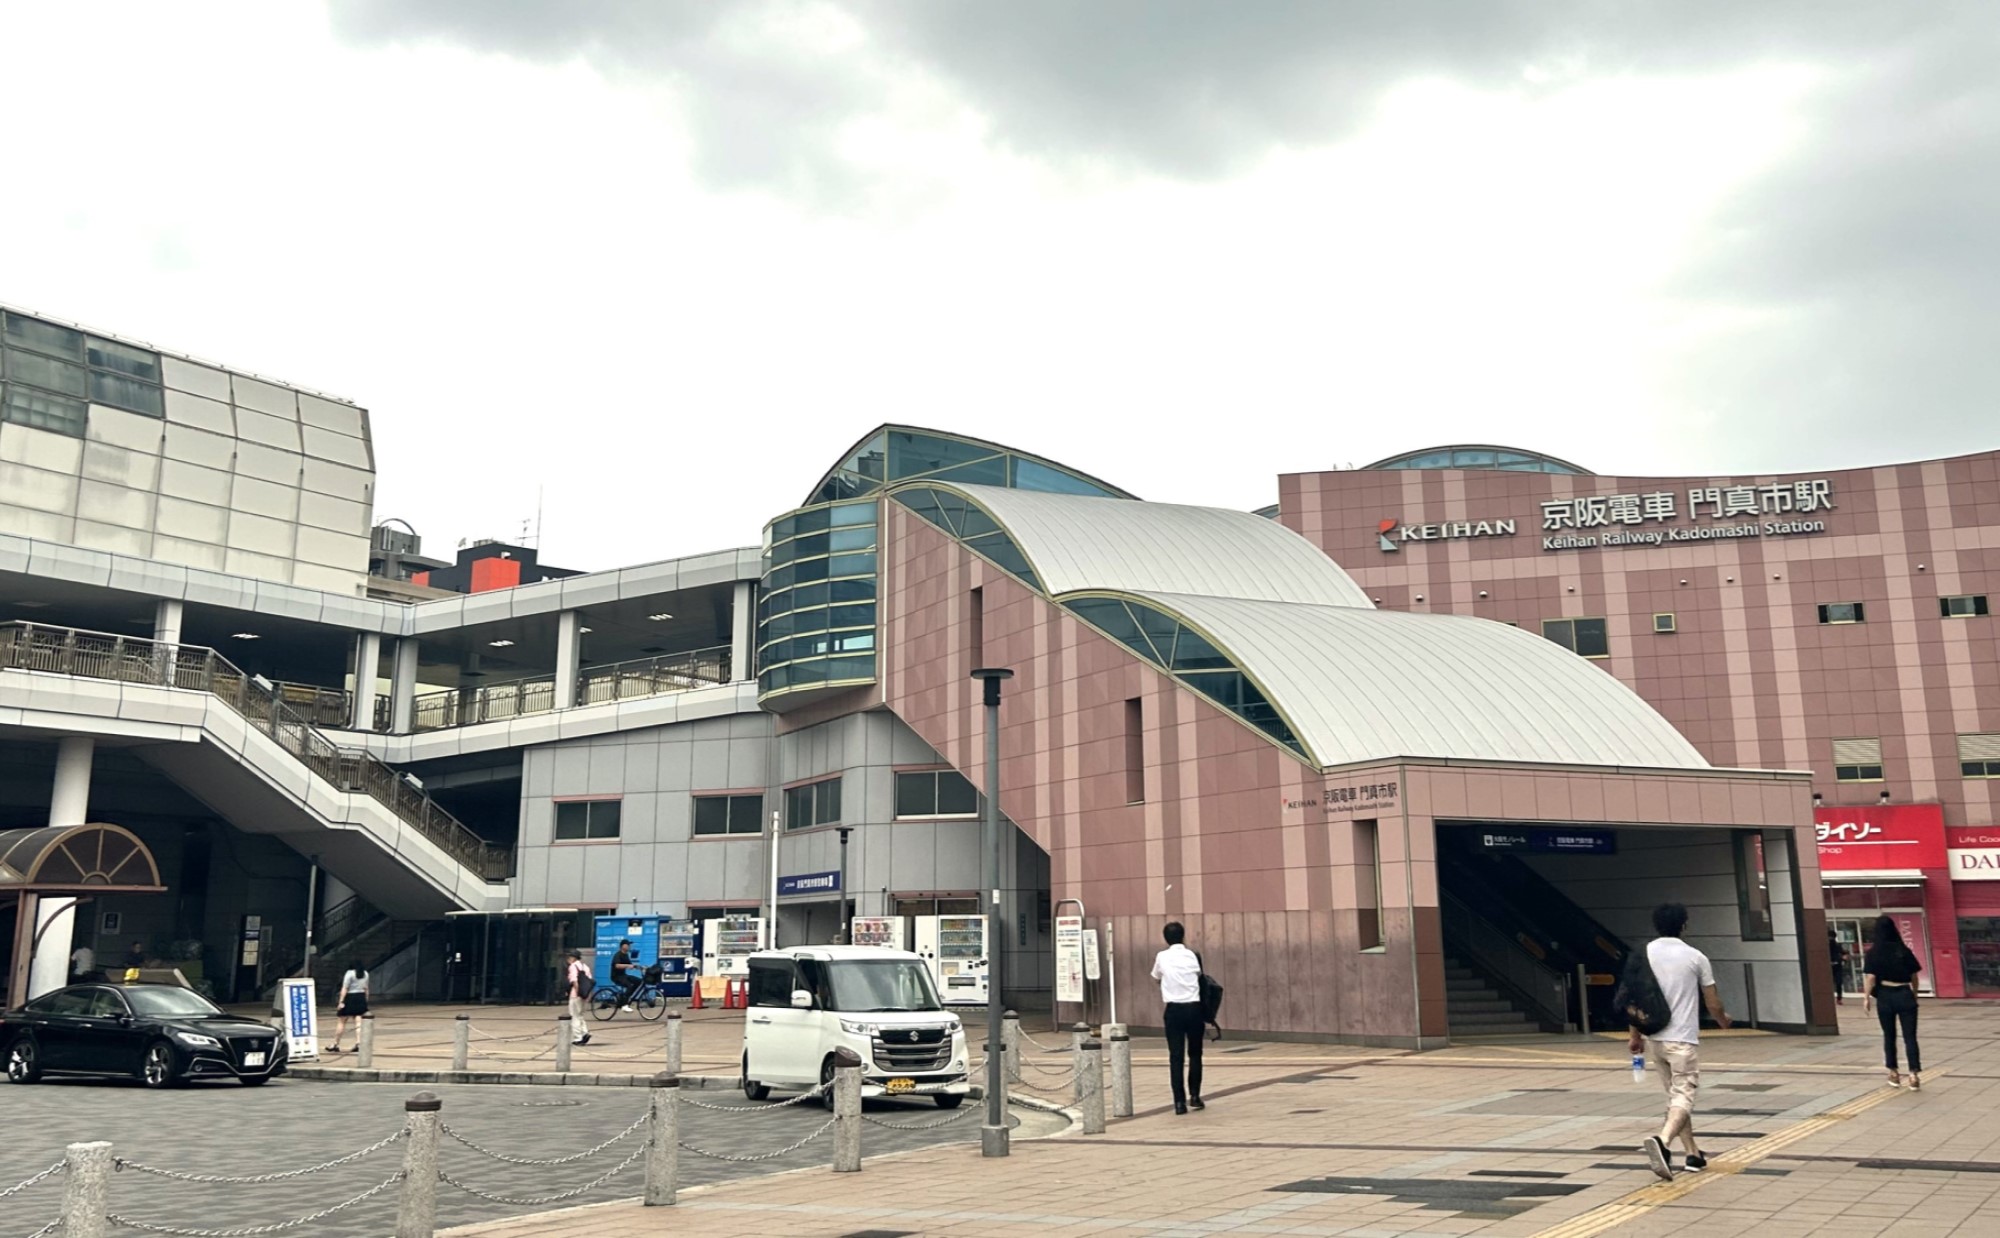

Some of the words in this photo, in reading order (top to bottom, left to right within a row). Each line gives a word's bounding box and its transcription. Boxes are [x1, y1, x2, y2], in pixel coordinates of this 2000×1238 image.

[1540, 491, 1677, 530] 京阪電車
[1688, 479, 1831, 519] 門真市駅
[1400, 519, 1516, 541] KEIHAN
[1543, 534, 1598, 549] Keihan
[1601, 529, 1664, 546] Railway
[1668, 522, 1760, 541] Kadomashi
[1764, 518, 1825, 535] Station
[1288, 799, 1318, 809] KEIHAN
[1815, 822, 1882, 841] ダイソー
[1958, 835, 1977, 844] Life
